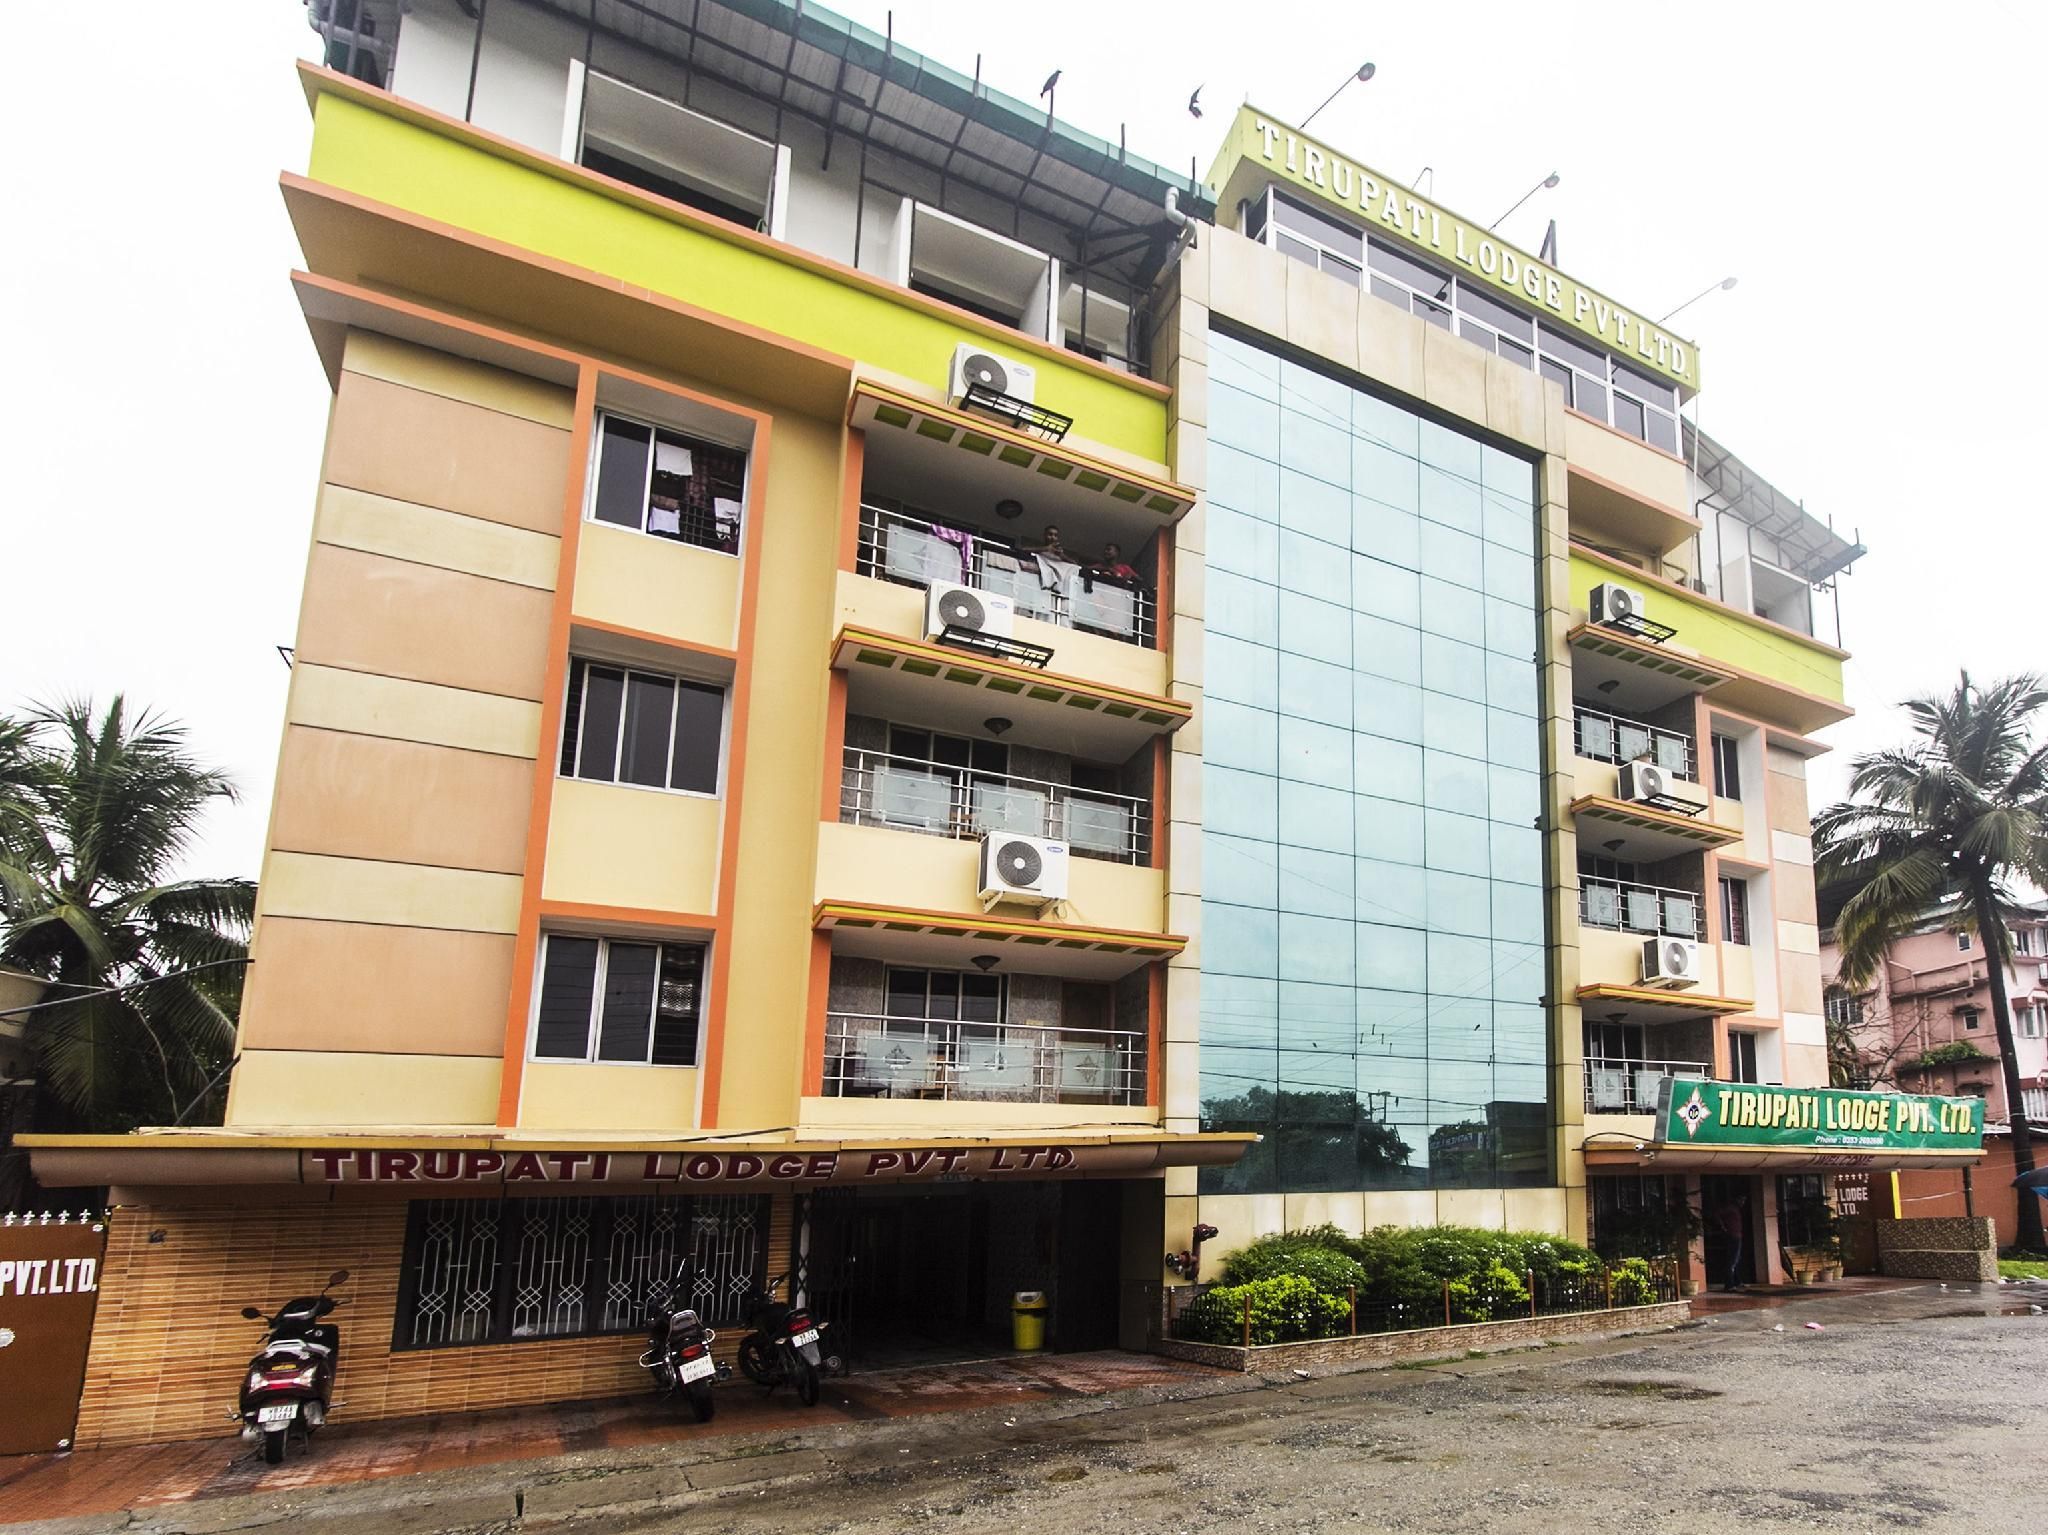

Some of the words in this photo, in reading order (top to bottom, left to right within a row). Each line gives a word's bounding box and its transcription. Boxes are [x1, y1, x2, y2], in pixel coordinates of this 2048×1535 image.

[1256, 118, 1441, 248] TIRUPATI
[1455, 225, 1561, 311] LODGE
[1574, 288, 1630, 347] PVT.
[1638, 322, 1691, 379] LTD.
[1718, 1090, 1819, 1129] TIRUPATI
[1826, 1097, 1890, 1132] LODGE
[1896, 1101, 1935, 1133] PVT.
[1940, 1103, 1976, 1134] LTD.
[1815, 1135, 1838, 1144] Phone
[312, 1151, 612, 1181] TIRUPATI
[643, 1153, 839, 1182] LODGE
[865, 1149, 968, 1176] PVT.
[989, 1147, 1079, 1171] LTD.
[1816, 1154, 1876, 1166] WELCOME
[1840, 1187, 1868, 1201] LODGE
[1838, 1203, 1860, 1215] LTD.
